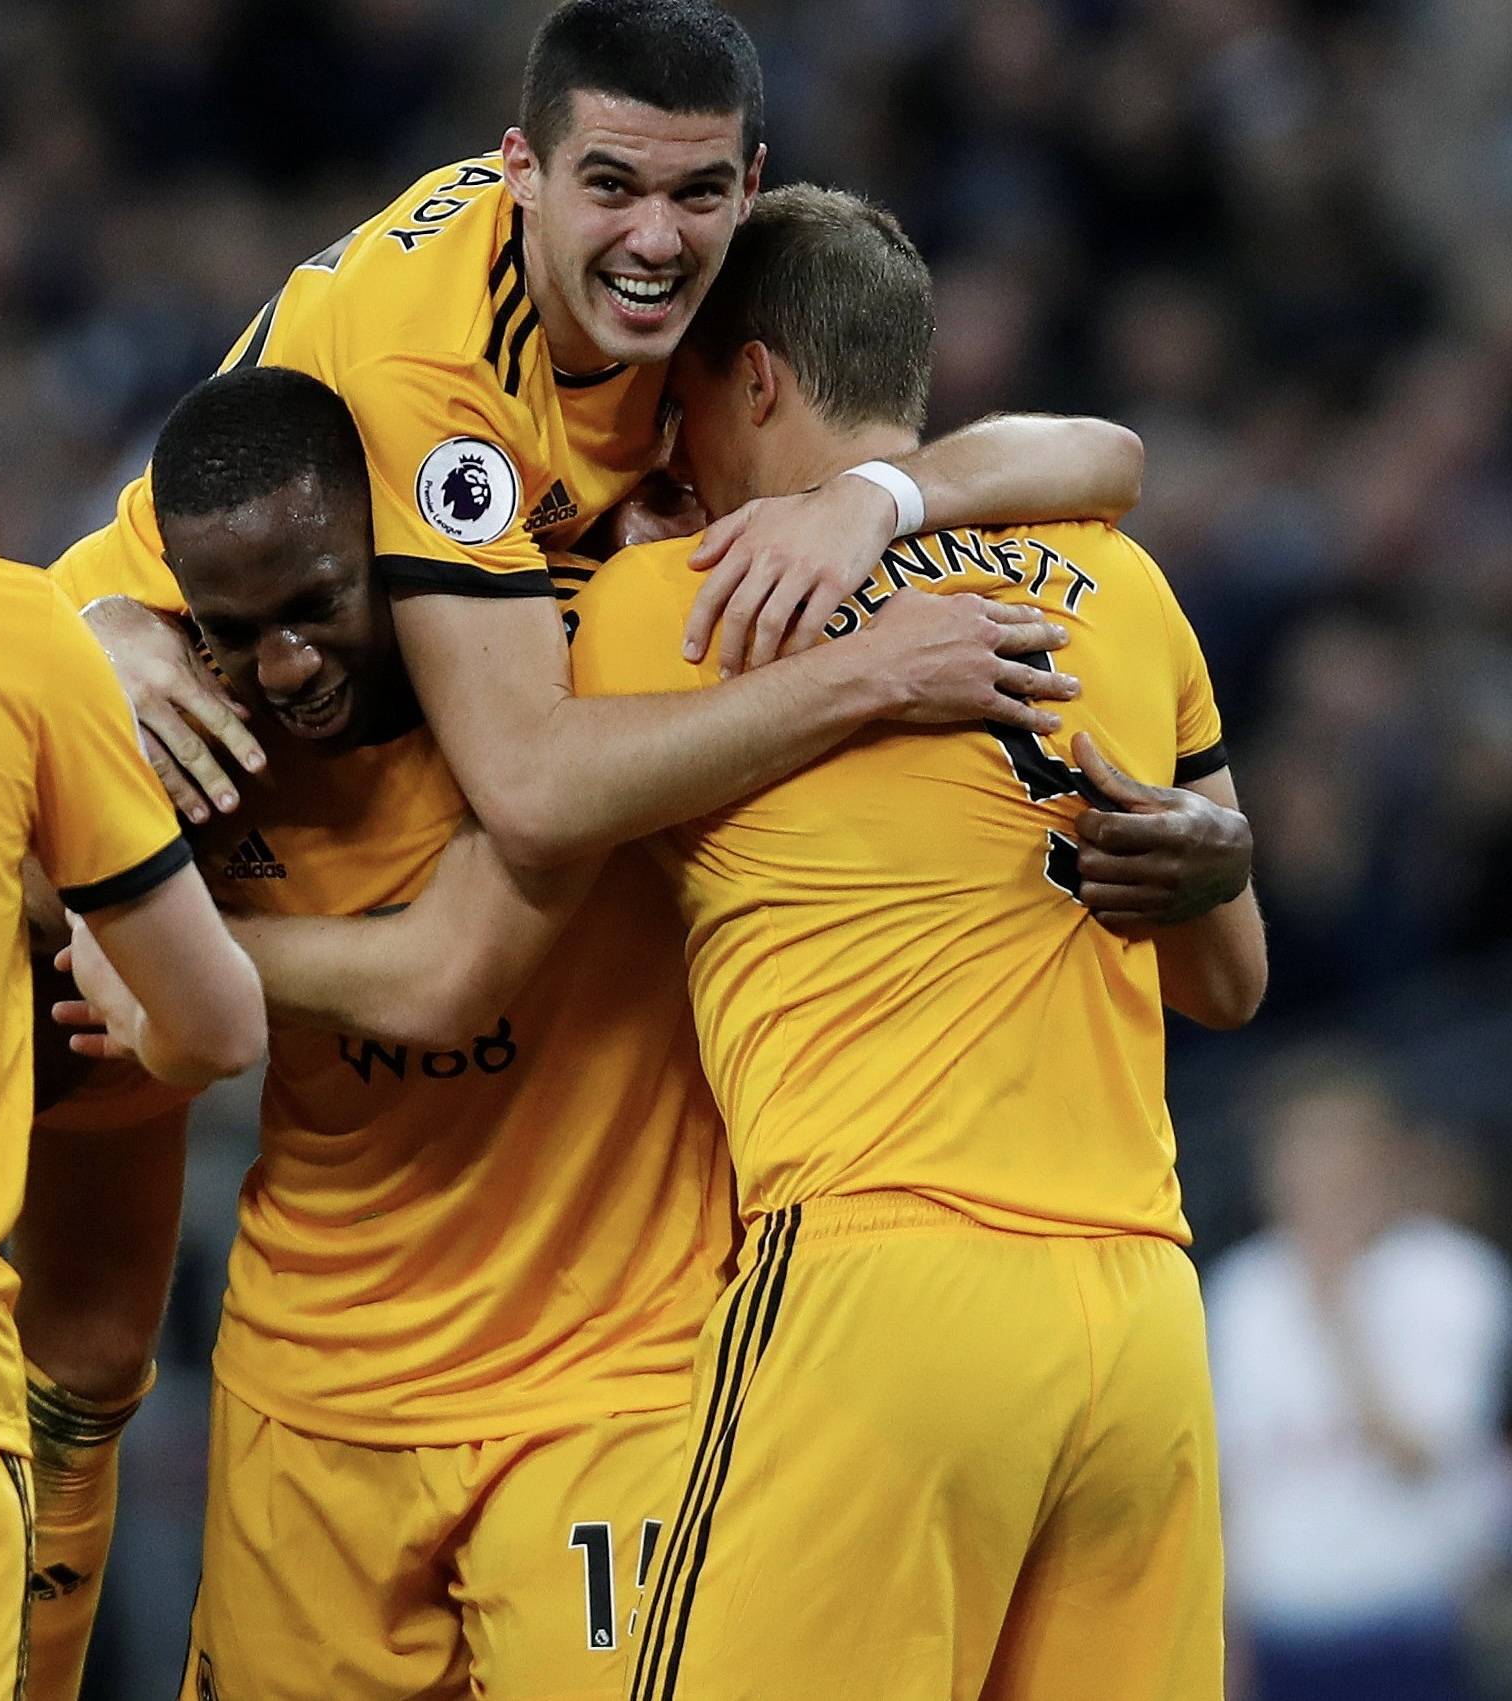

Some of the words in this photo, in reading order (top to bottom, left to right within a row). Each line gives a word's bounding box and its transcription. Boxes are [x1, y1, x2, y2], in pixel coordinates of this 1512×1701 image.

[385, 163, 505, 254] ADY
[425, 480, 435, 514] Premier
[433, 513, 463, 536] League
[521, 503, 579, 533] adidas
[224, 861, 288, 880] adidas
[568, 1519, 664, 1651] 1
